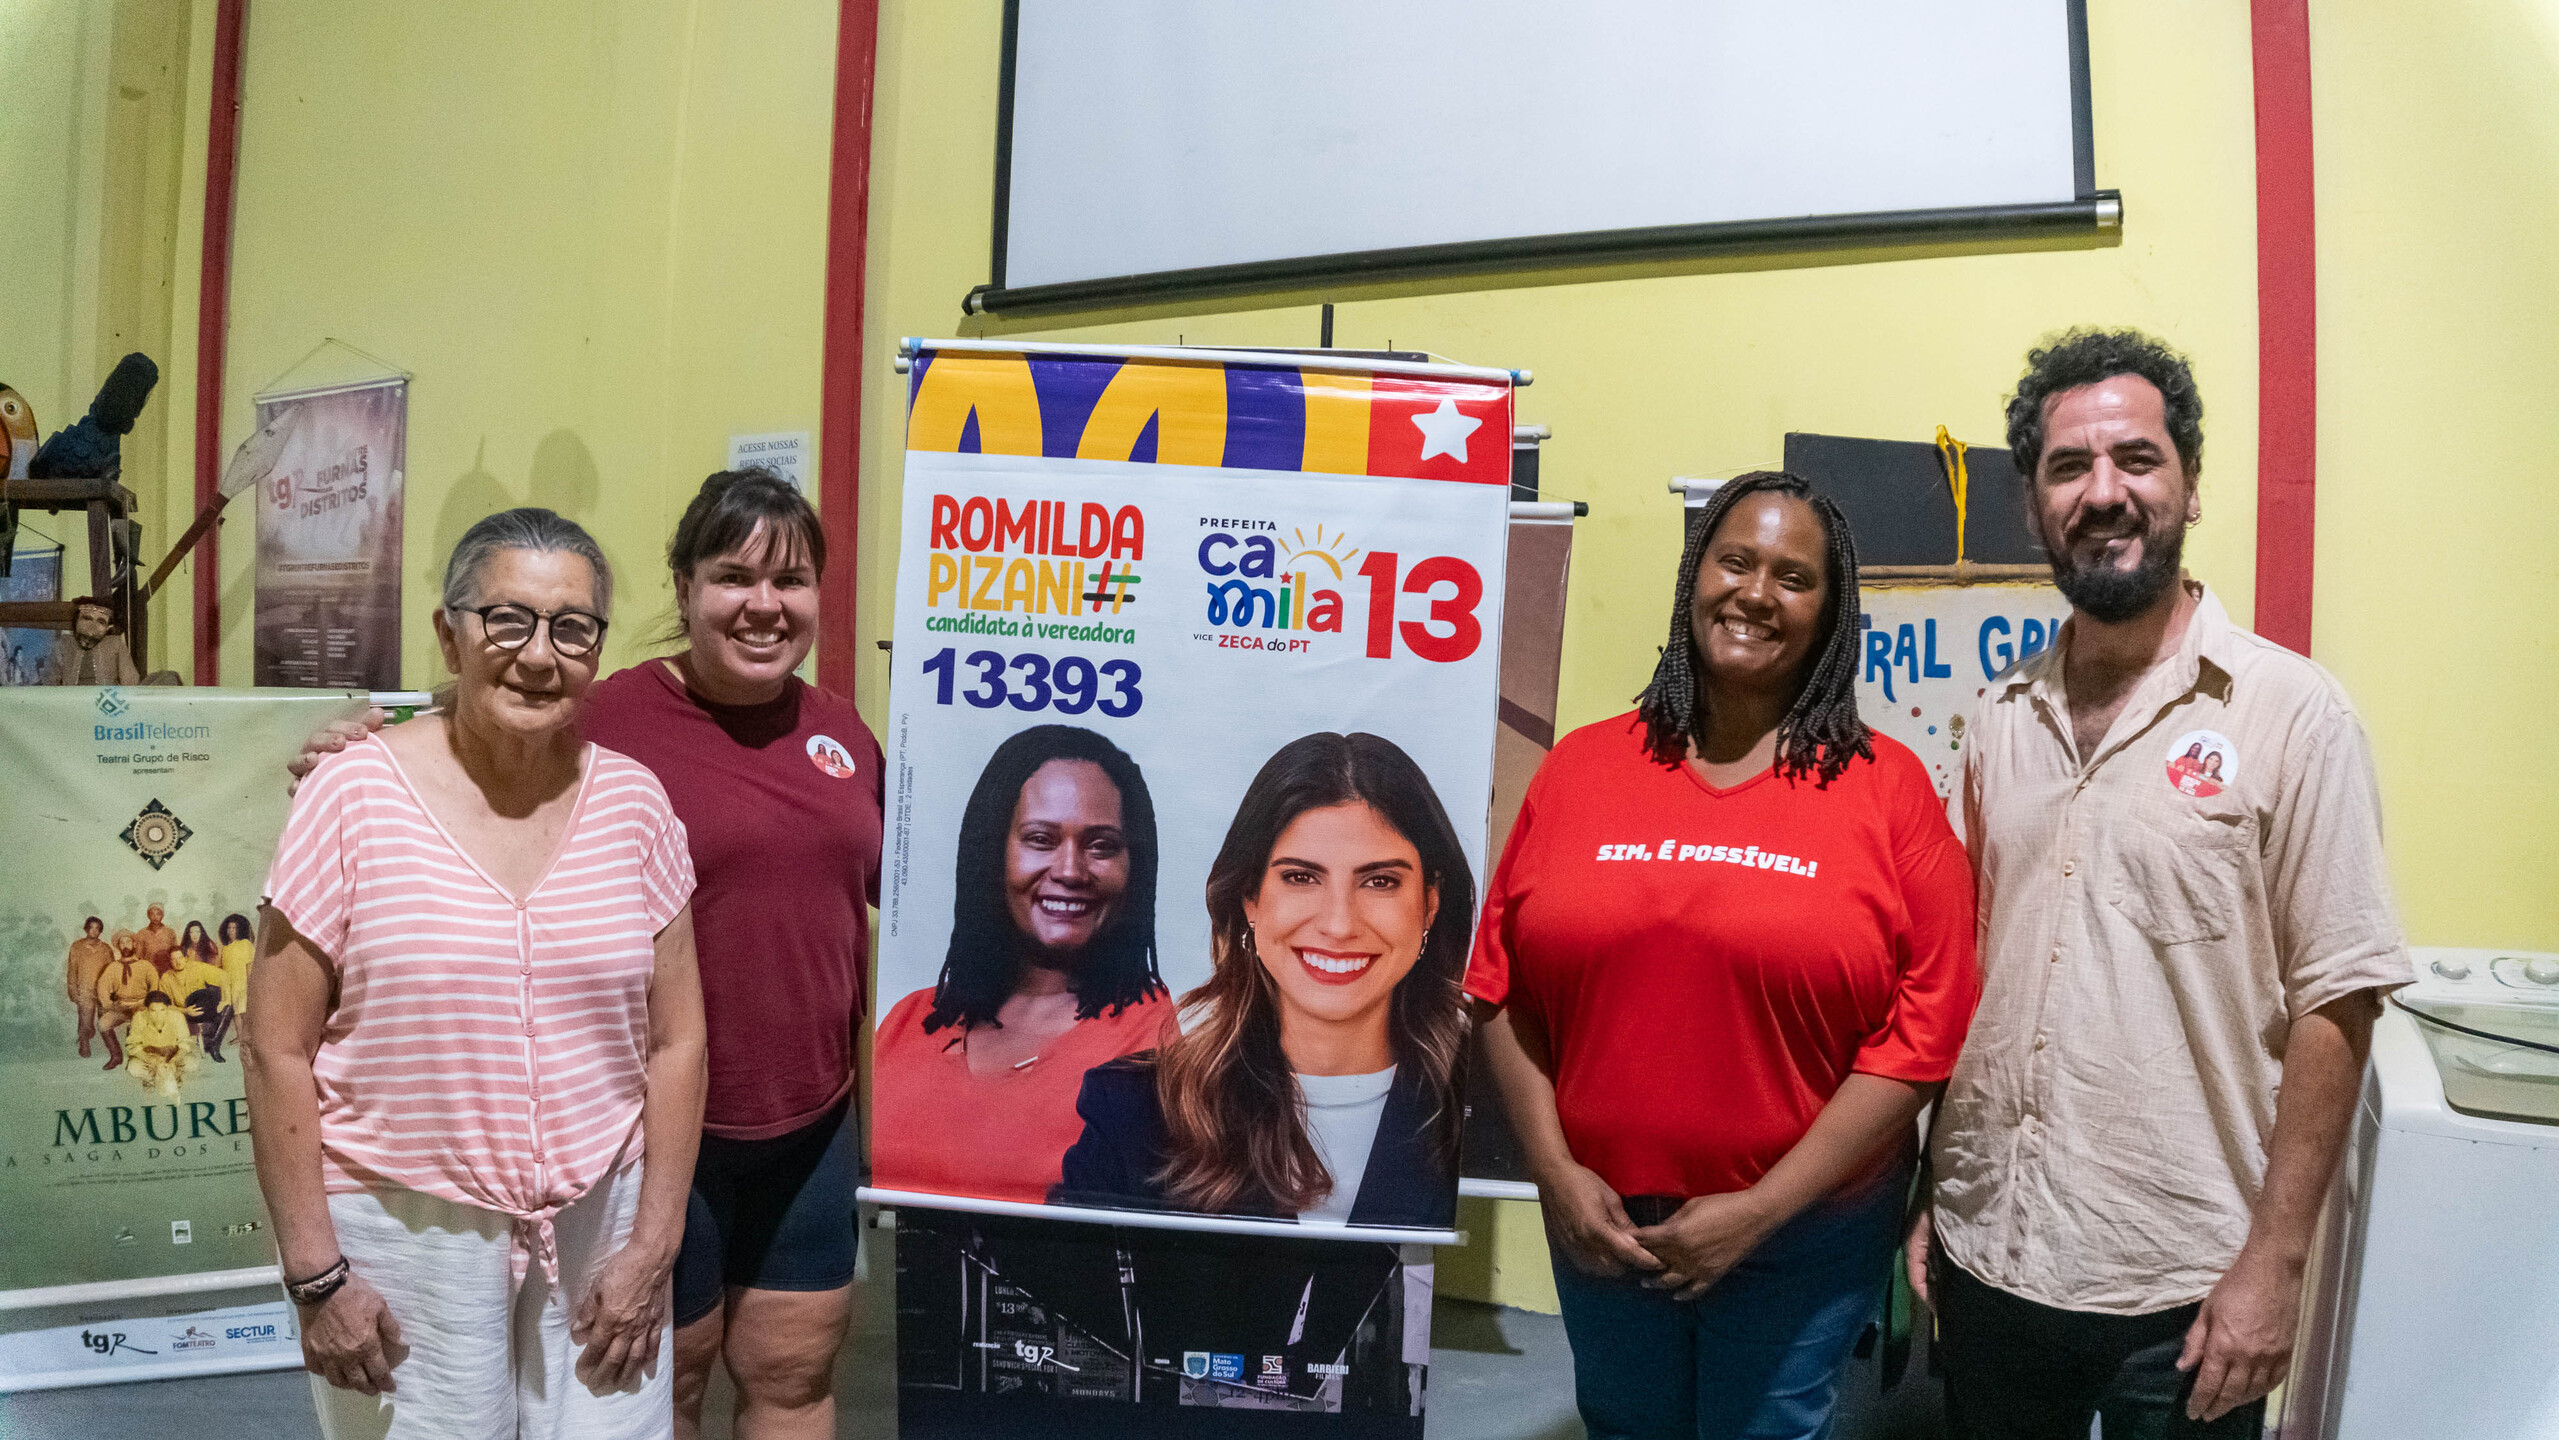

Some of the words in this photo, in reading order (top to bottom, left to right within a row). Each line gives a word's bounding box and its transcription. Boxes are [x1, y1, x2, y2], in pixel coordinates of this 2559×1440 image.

[738, 442, 766, 453] ACESSE
[768, 439, 798, 450] NOSSAS
[740, 457, 765, 468] REDES
[766, 455, 797, 466] SOCIAIS
[930, 494, 1144, 561] ROMILDA
[1200, 517, 1277, 531] PREFEITA
[1357, 551, 1483, 663] 13
[926, 612, 1018, 637] candidata
[1021, 615, 1033, 637] à
[1038, 621, 1135, 644] vereadora
[1193, 634, 1213, 642] VICE
[1219, 634, 1263, 651] ZECA
[1267, 638, 1286, 652] do
[1289, 640, 1311, 653] PT
[922, 647, 1143, 718] 13393
[97, 754, 130, 764] Teatral
[133, 753, 164, 764] Grupo
[167, 753, 179, 762] de
[182, 752, 210, 762] Risco
[898, 795, 904, 804] da
[895, 822, 903, 855] Federação
[1596, 843, 1652, 861] SIM,
[1657, 839, 1676, 860] É
[1678, 845, 1818, 878] POSSÍVEL!
[52, 1098, 251, 1147] MBURE
[7, 1156, 17, 1167] A
[43, 1149, 123, 1165] SAGA
[148, 1144, 207, 1159] DOS
[225, 1324, 276, 1340] SECTUR
[1212, 1364, 1238, 1372] Grosso
[1307, 1363, 1349, 1375] BARBIERI
